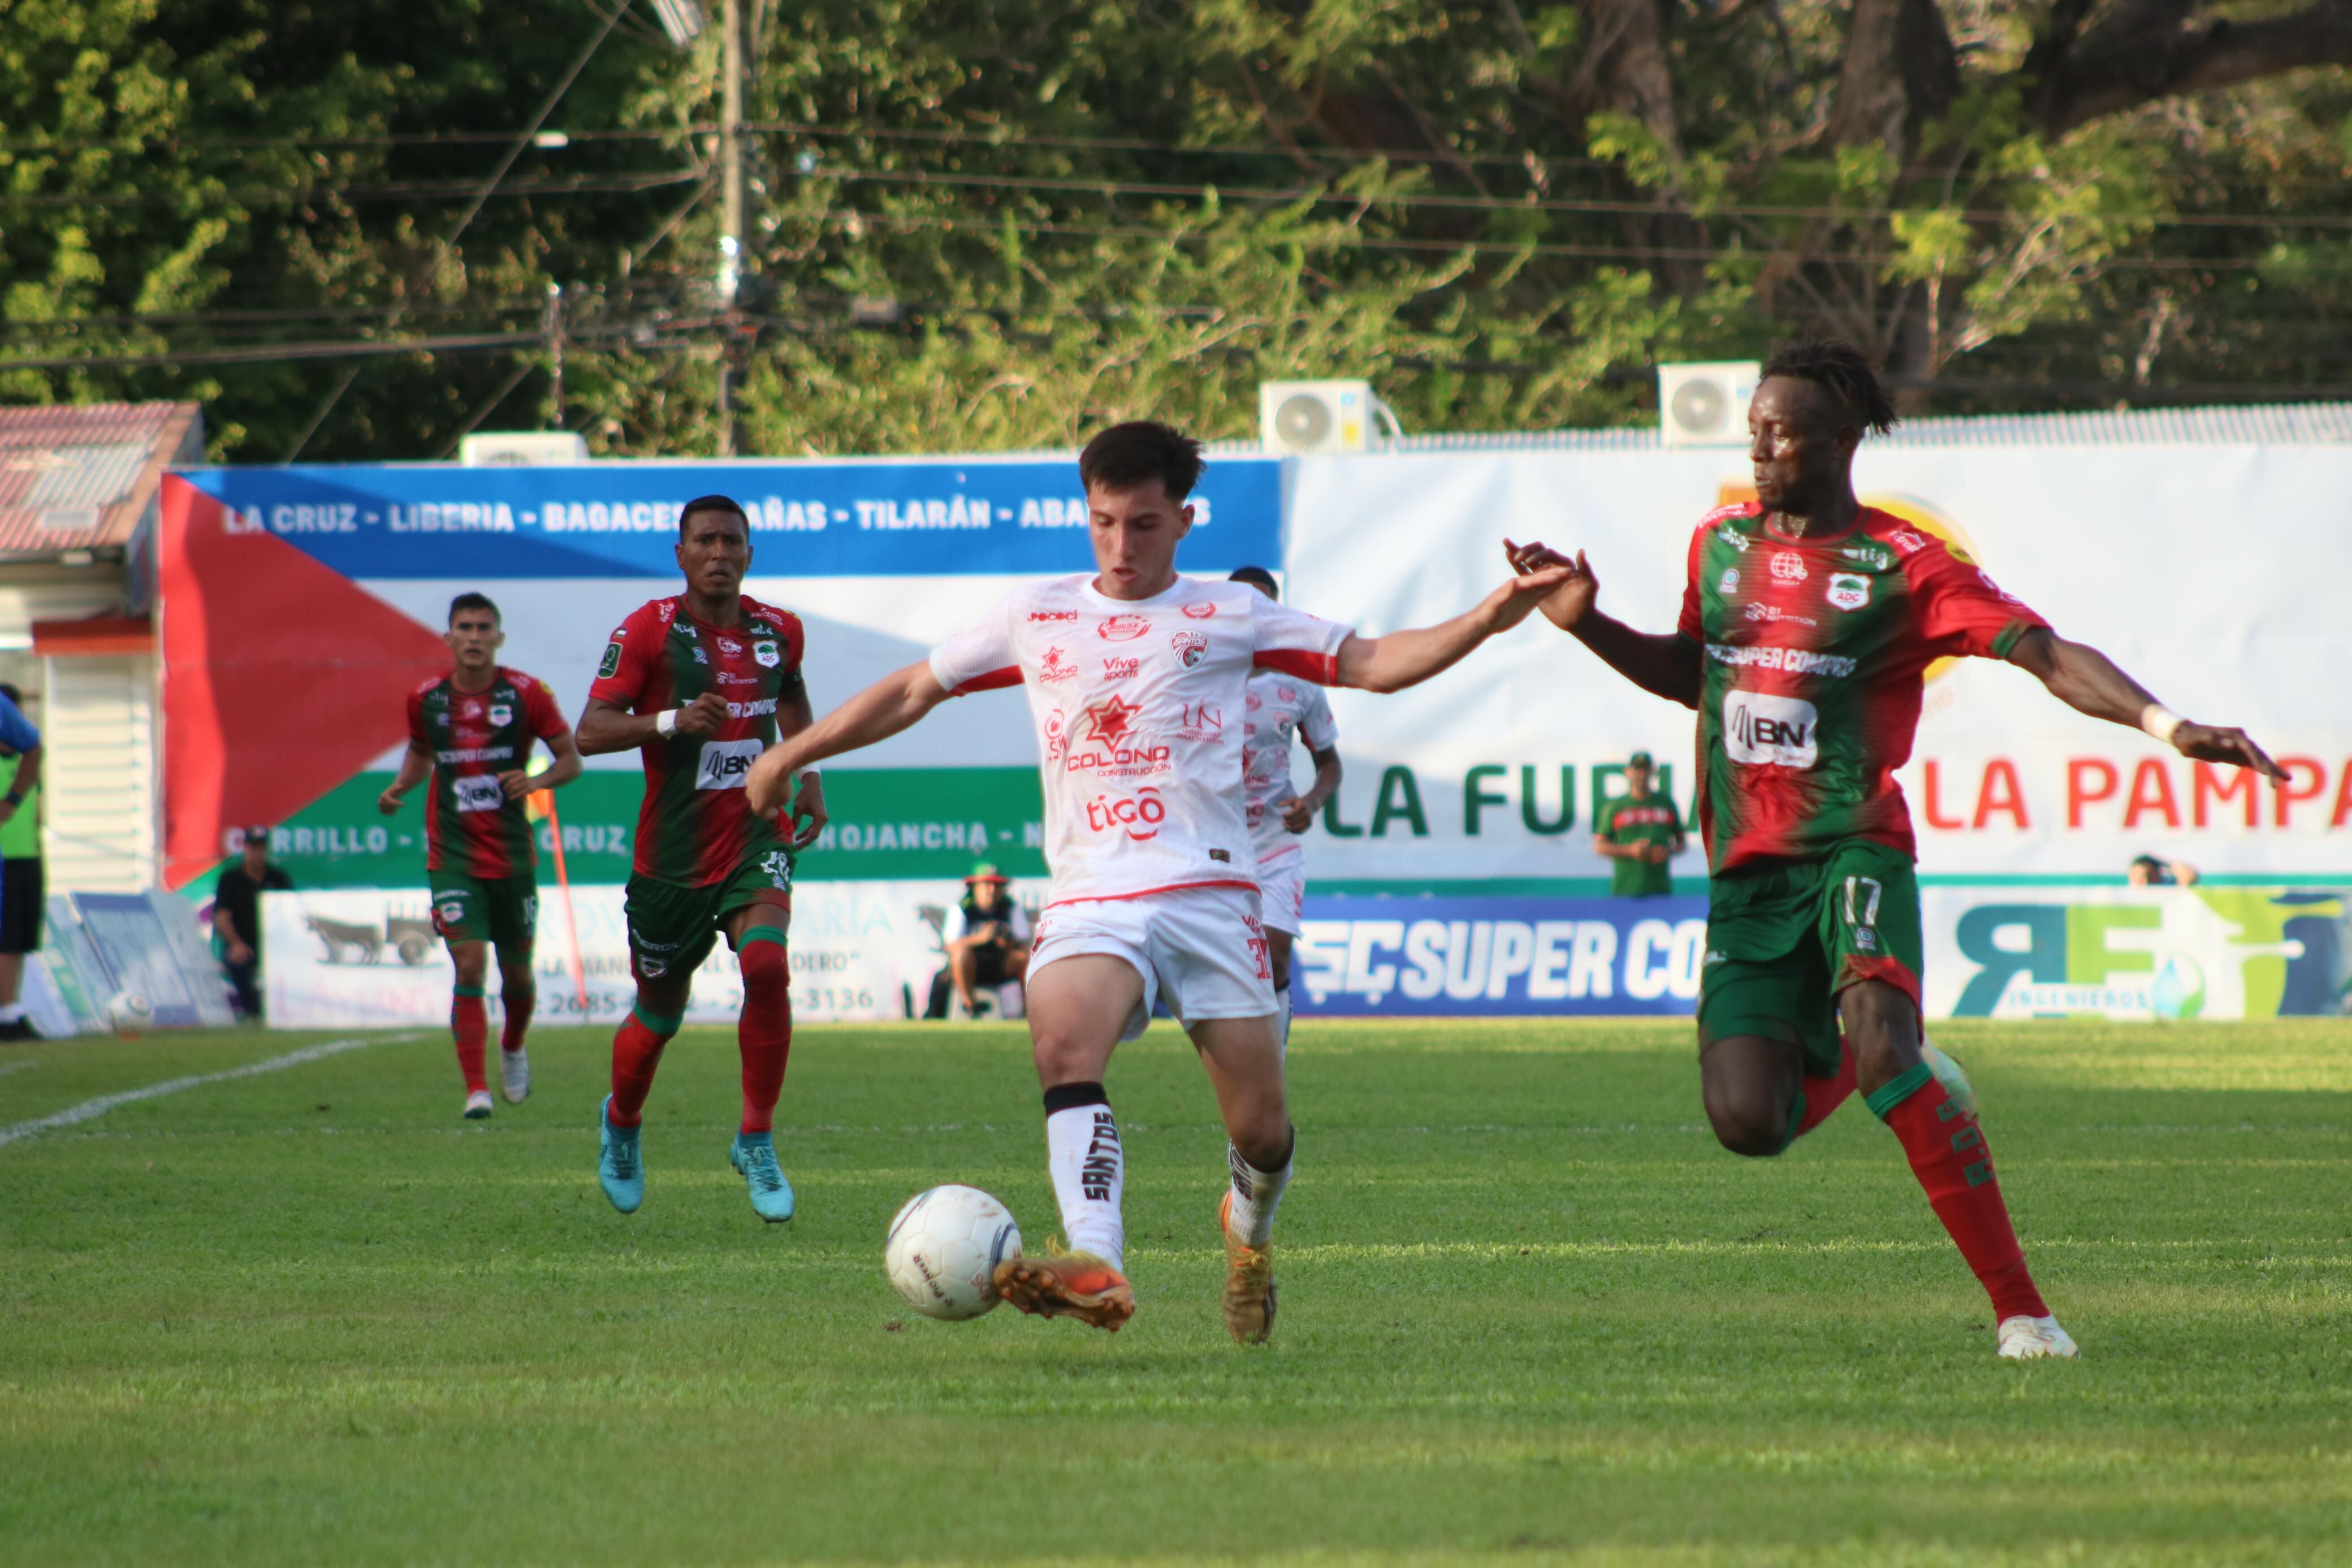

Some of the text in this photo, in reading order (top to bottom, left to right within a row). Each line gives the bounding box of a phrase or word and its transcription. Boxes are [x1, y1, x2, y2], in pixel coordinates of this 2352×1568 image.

[223, 504, 265, 533] LA
[274, 503, 357, 532] CRUZ
[391, 502, 515, 531] LIBERIA
[745, 496, 826, 530] AÑAS
[854, 495, 991, 530] TILARÁN
[1104, 657, 1139, 671] Vive
[1104, 669, 1139, 680] sports
[1755, 717, 1805, 747] BN
[1067, 746, 1170, 772] COLONO
[1097, 763, 1171, 777] CONSTRUCCIÓN
[1923, 757, 2031, 830] LA
[224, 827, 388, 853] CRRILLO
[1844, 876, 1882, 925] 17
[1400, 920, 1618, 999] SUPER
[2009, 989, 2148, 1010] INGENIEROS
[1082, 1112, 1119, 1202] SANTOS
[913, 1251, 945, 1299] PIONEER
